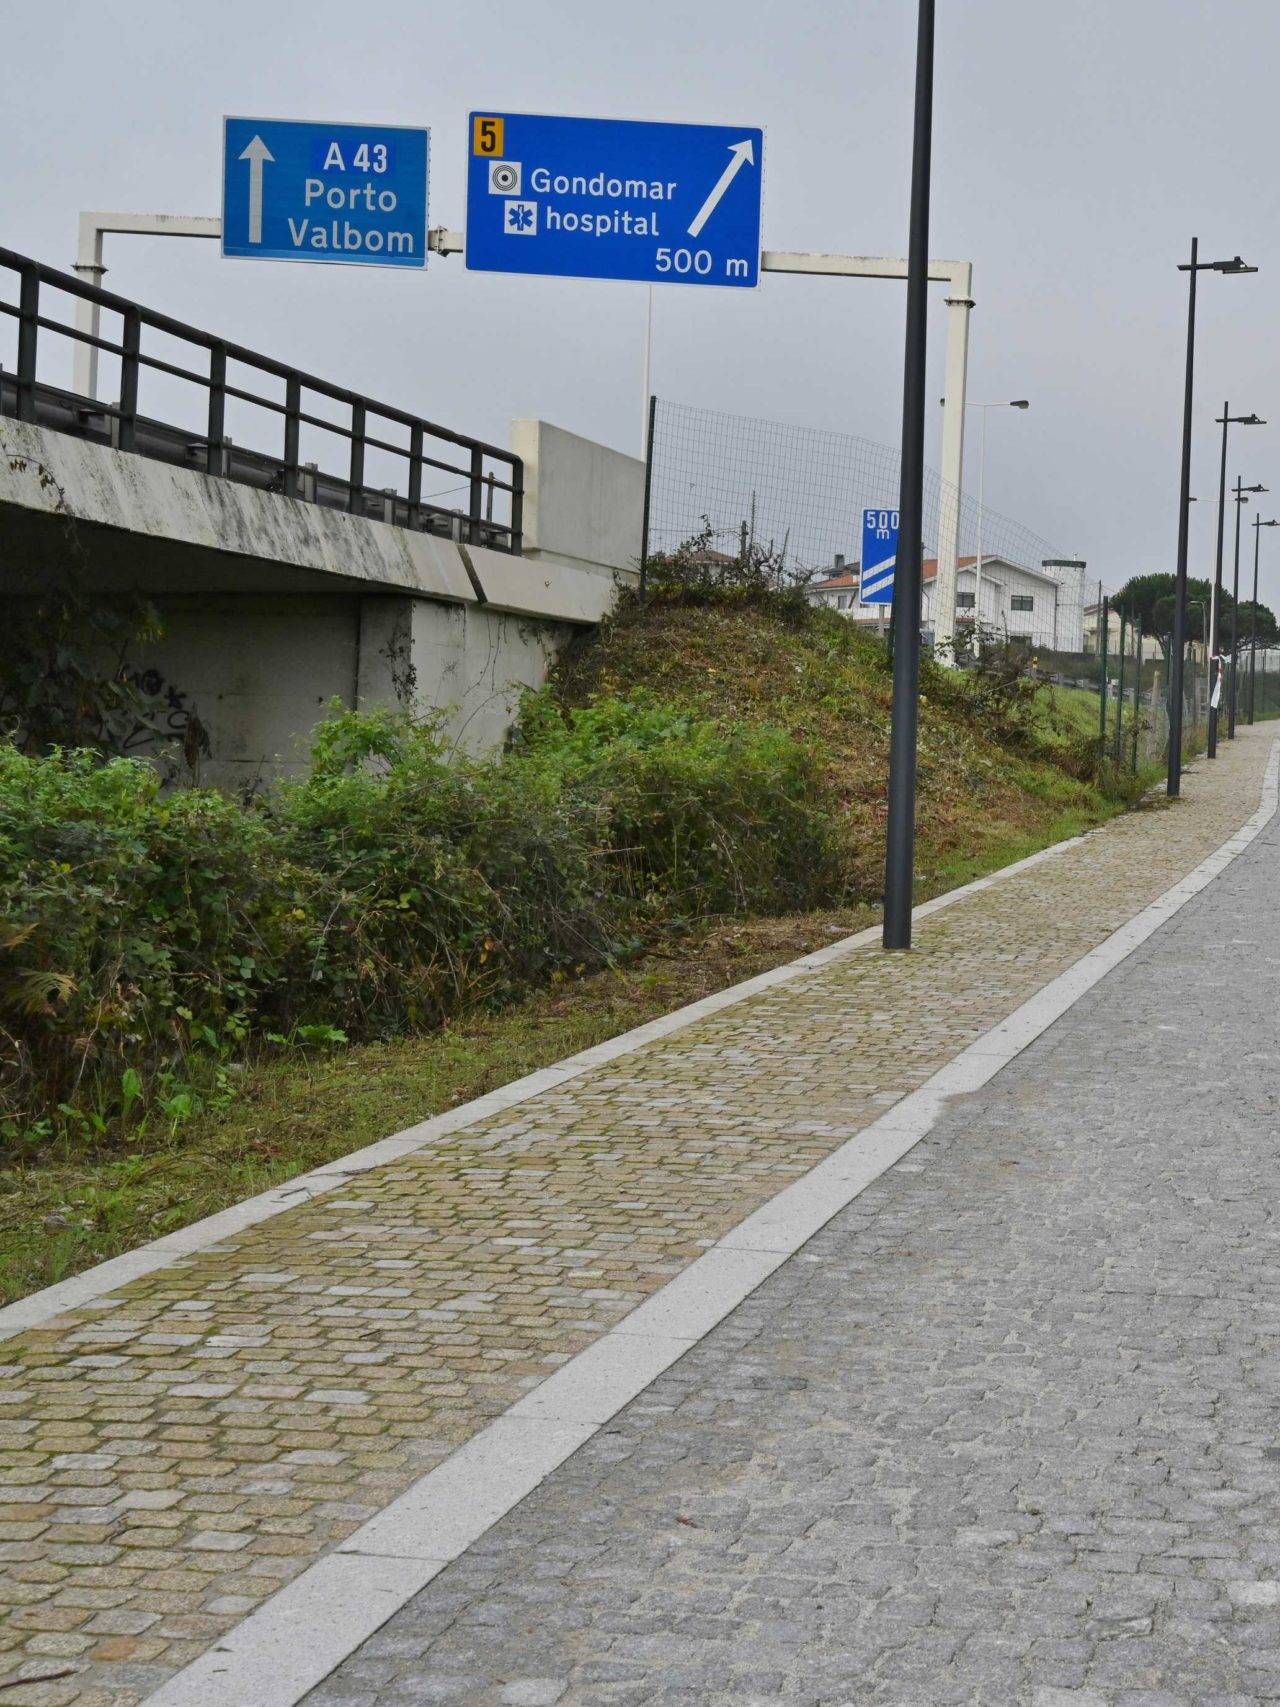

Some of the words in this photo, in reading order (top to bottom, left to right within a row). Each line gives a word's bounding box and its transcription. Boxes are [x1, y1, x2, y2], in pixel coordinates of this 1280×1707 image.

[479, 120, 497, 153] 5
[323, 141, 346, 171] A
[353, 143, 388, 174] 43
[304, 178, 397, 212] Porto
[530, 167, 678, 201] Gondomar
[287, 217, 414, 253] Valbom
[546, 205, 660, 237] hospital
[655, 247, 713, 275] 500
[725, 256, 749, 278] m
[866, 511, 900, 530] 500
[876, 529, 890, 540] m
